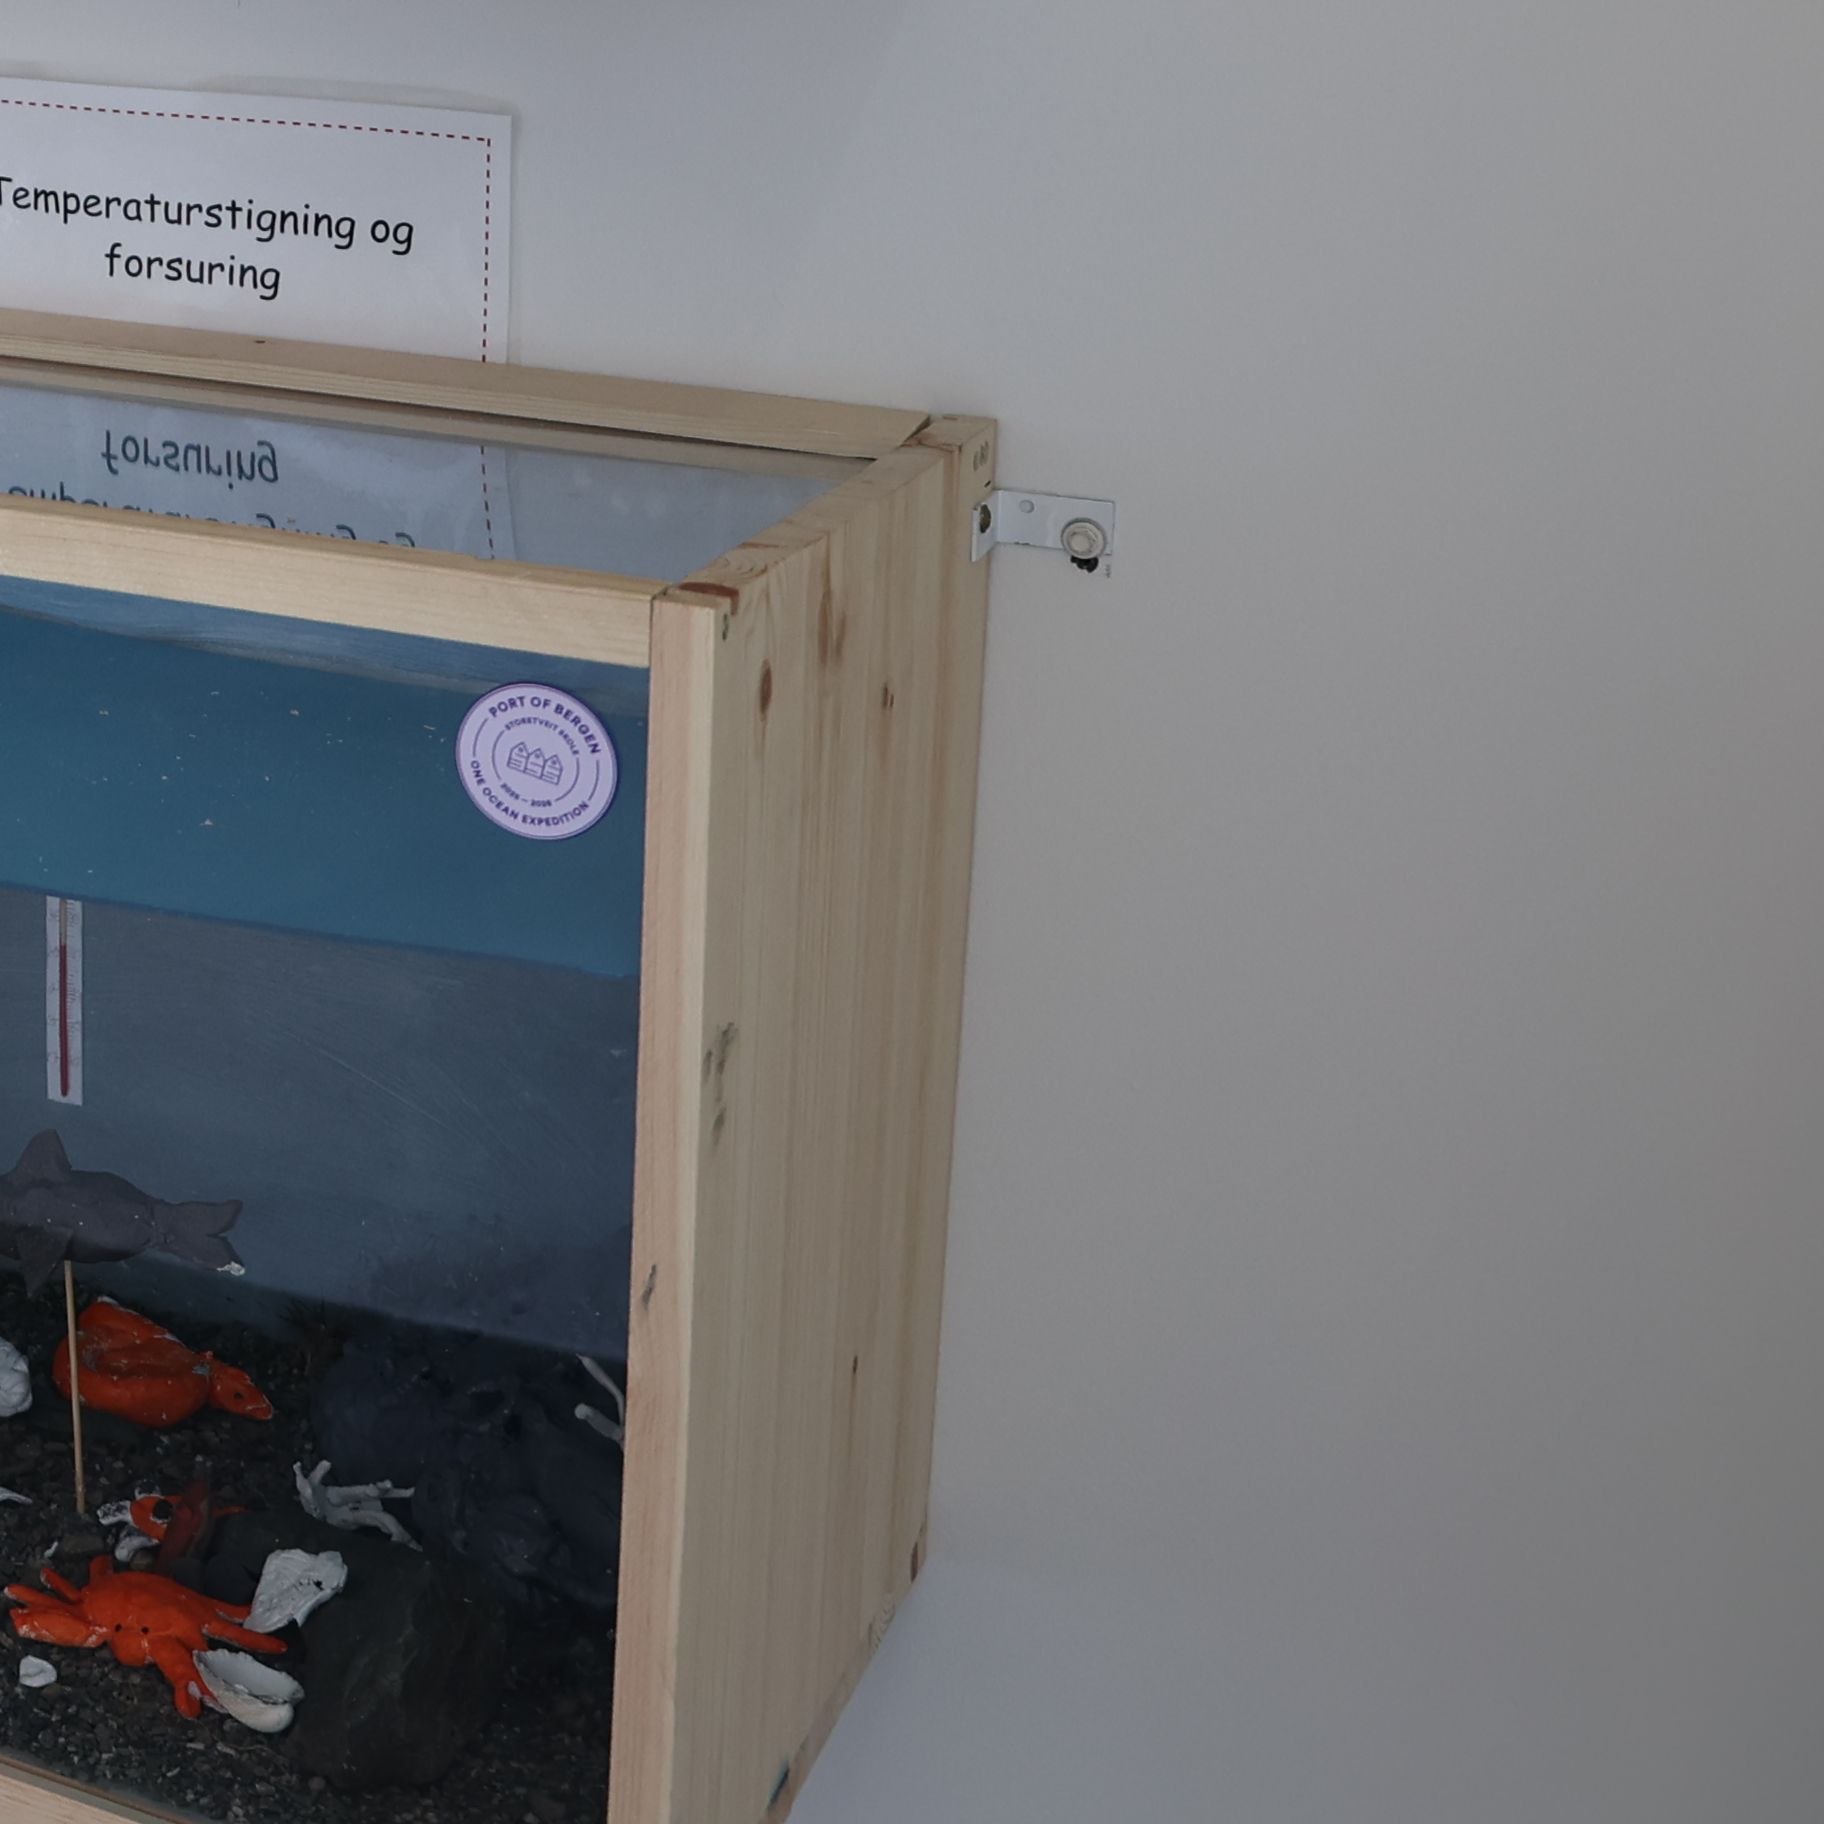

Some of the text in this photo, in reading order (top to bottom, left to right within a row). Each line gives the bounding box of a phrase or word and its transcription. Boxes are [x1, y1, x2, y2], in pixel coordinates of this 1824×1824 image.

[369, 217, 415, 256] og
[104, 242, 282, 301] forsuring
[488, 695, 602, 755] PORT OF BERGEN
[470, 759, 486, 786] ONE
[482, 786, 520, 820] OCEAN
[521, 801, 590, 827] EXPEDITION
